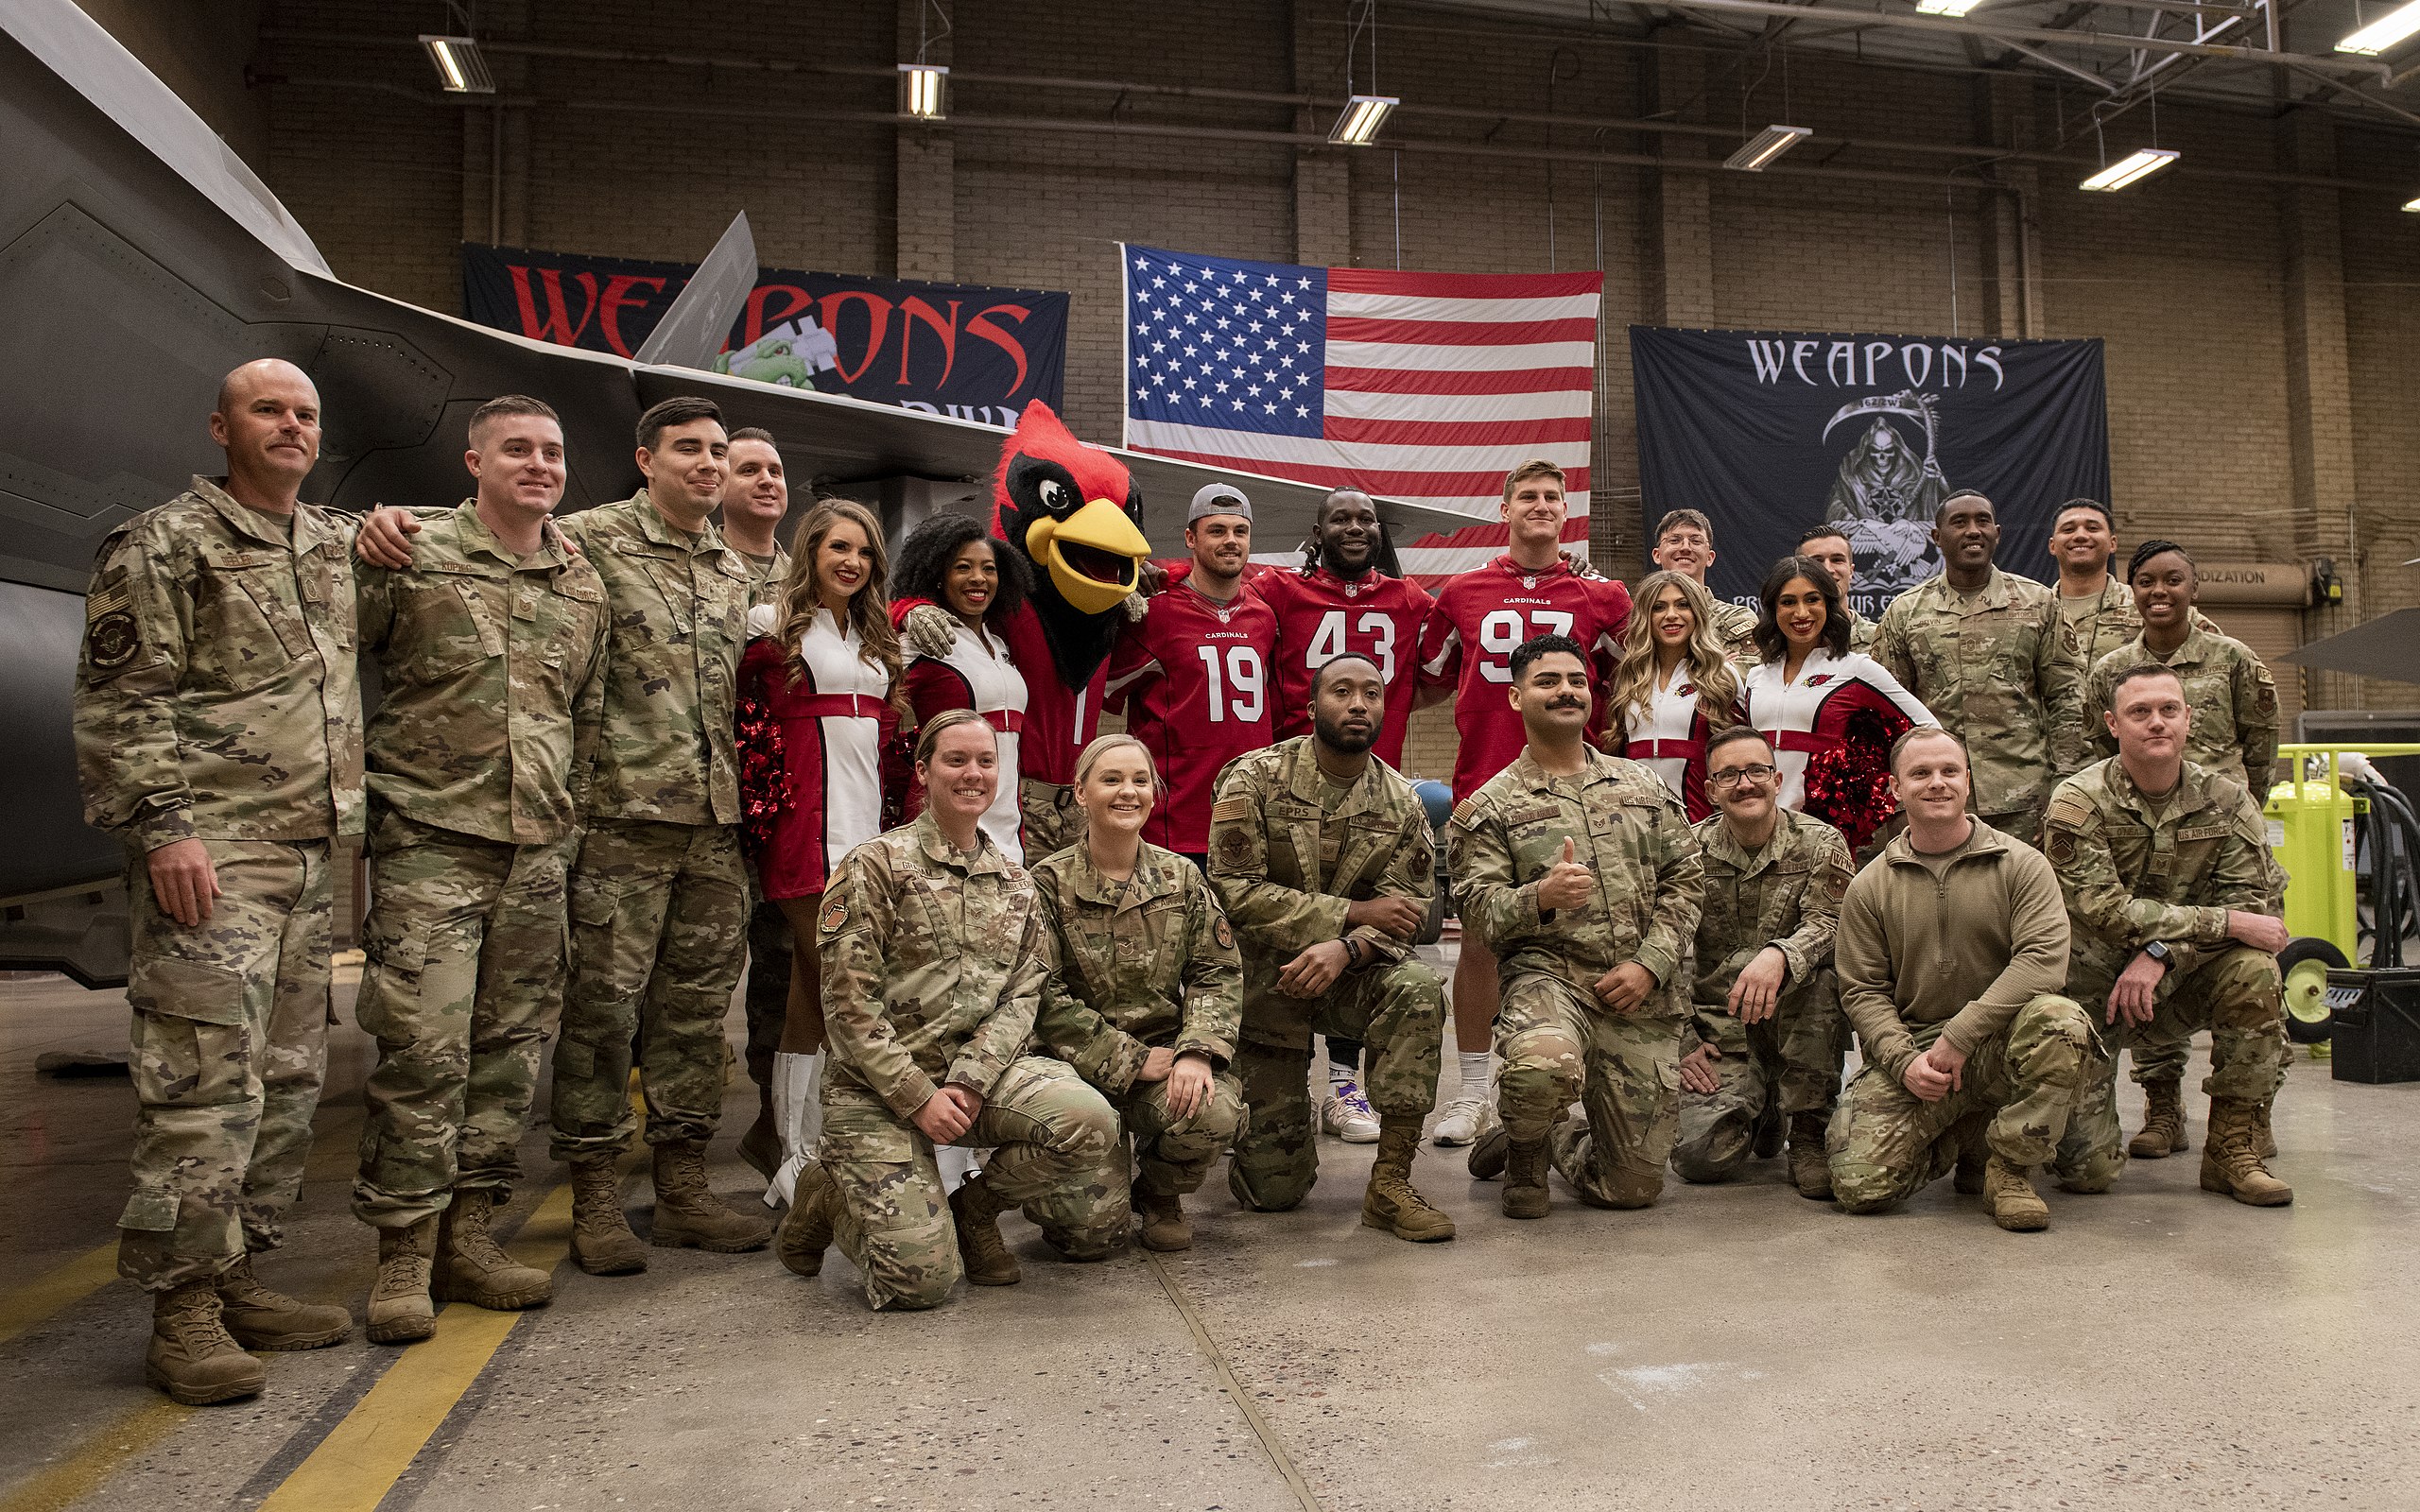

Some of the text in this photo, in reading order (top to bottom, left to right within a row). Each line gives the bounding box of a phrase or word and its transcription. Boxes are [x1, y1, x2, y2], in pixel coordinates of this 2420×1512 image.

[506, 265, 1032, 399] WEPONS
[1746, 338, 2005, 392] WEAPONS
[1503, 597, 1552, 606] CARDINALS
[1204, 631, 1249, 640] CARDINALS
[1305, 610, 1395, 686] 43
[1479, 609, 1574, 684] 97
[1198, 644, 1264, 723] 19
[1278, 806, 1309, 816] EPPS
[2204, 825, 2228, 837] FORCE
